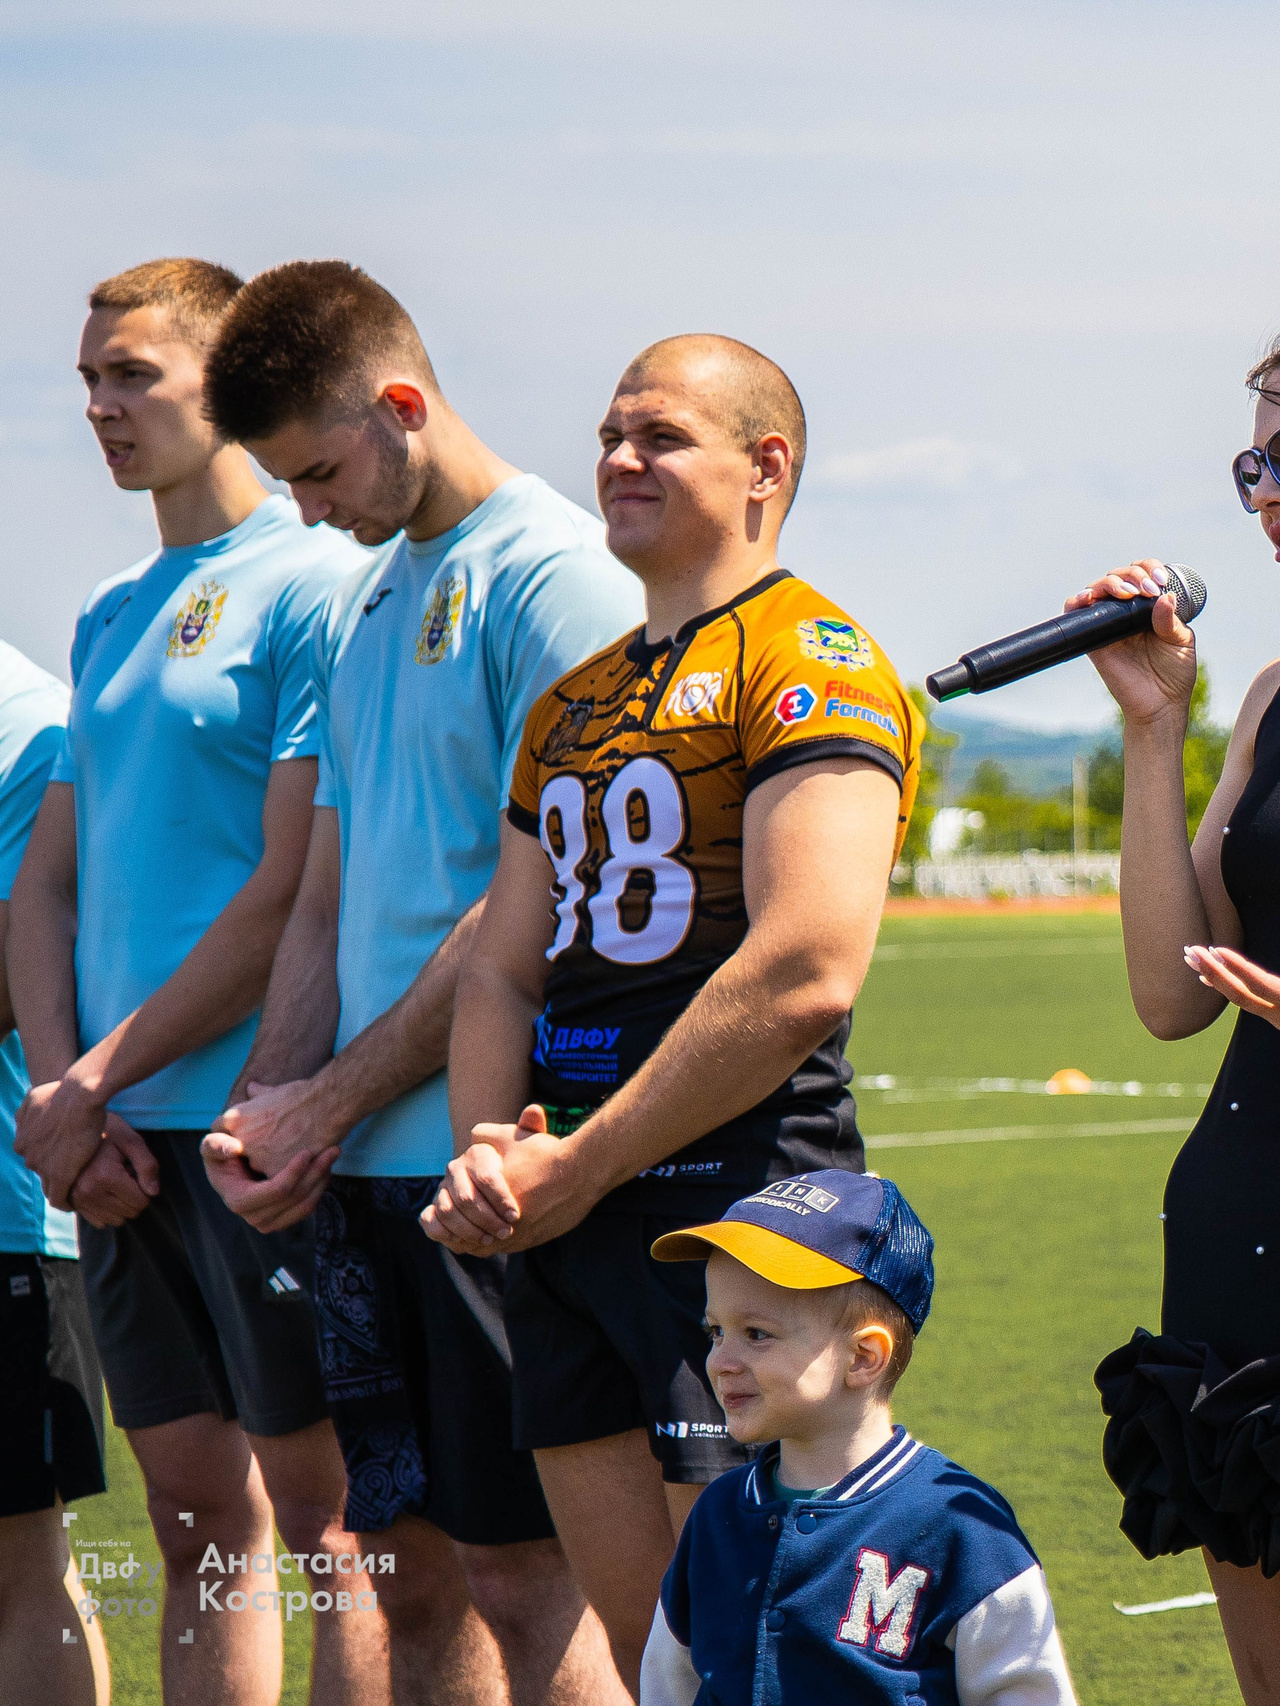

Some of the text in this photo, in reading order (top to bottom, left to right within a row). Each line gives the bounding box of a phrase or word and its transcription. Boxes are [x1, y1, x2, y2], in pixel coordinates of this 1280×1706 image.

[824, 680, 896, 714] Fitness
[825, 698, 899, 737] Formula
[552, 1026, 621, 1051] ДВФУ
[679, 1162, 723, 1172] SPORT
[691, 1423, 729, 1433] SPORT
[836, 1548, 933, 1661] M
